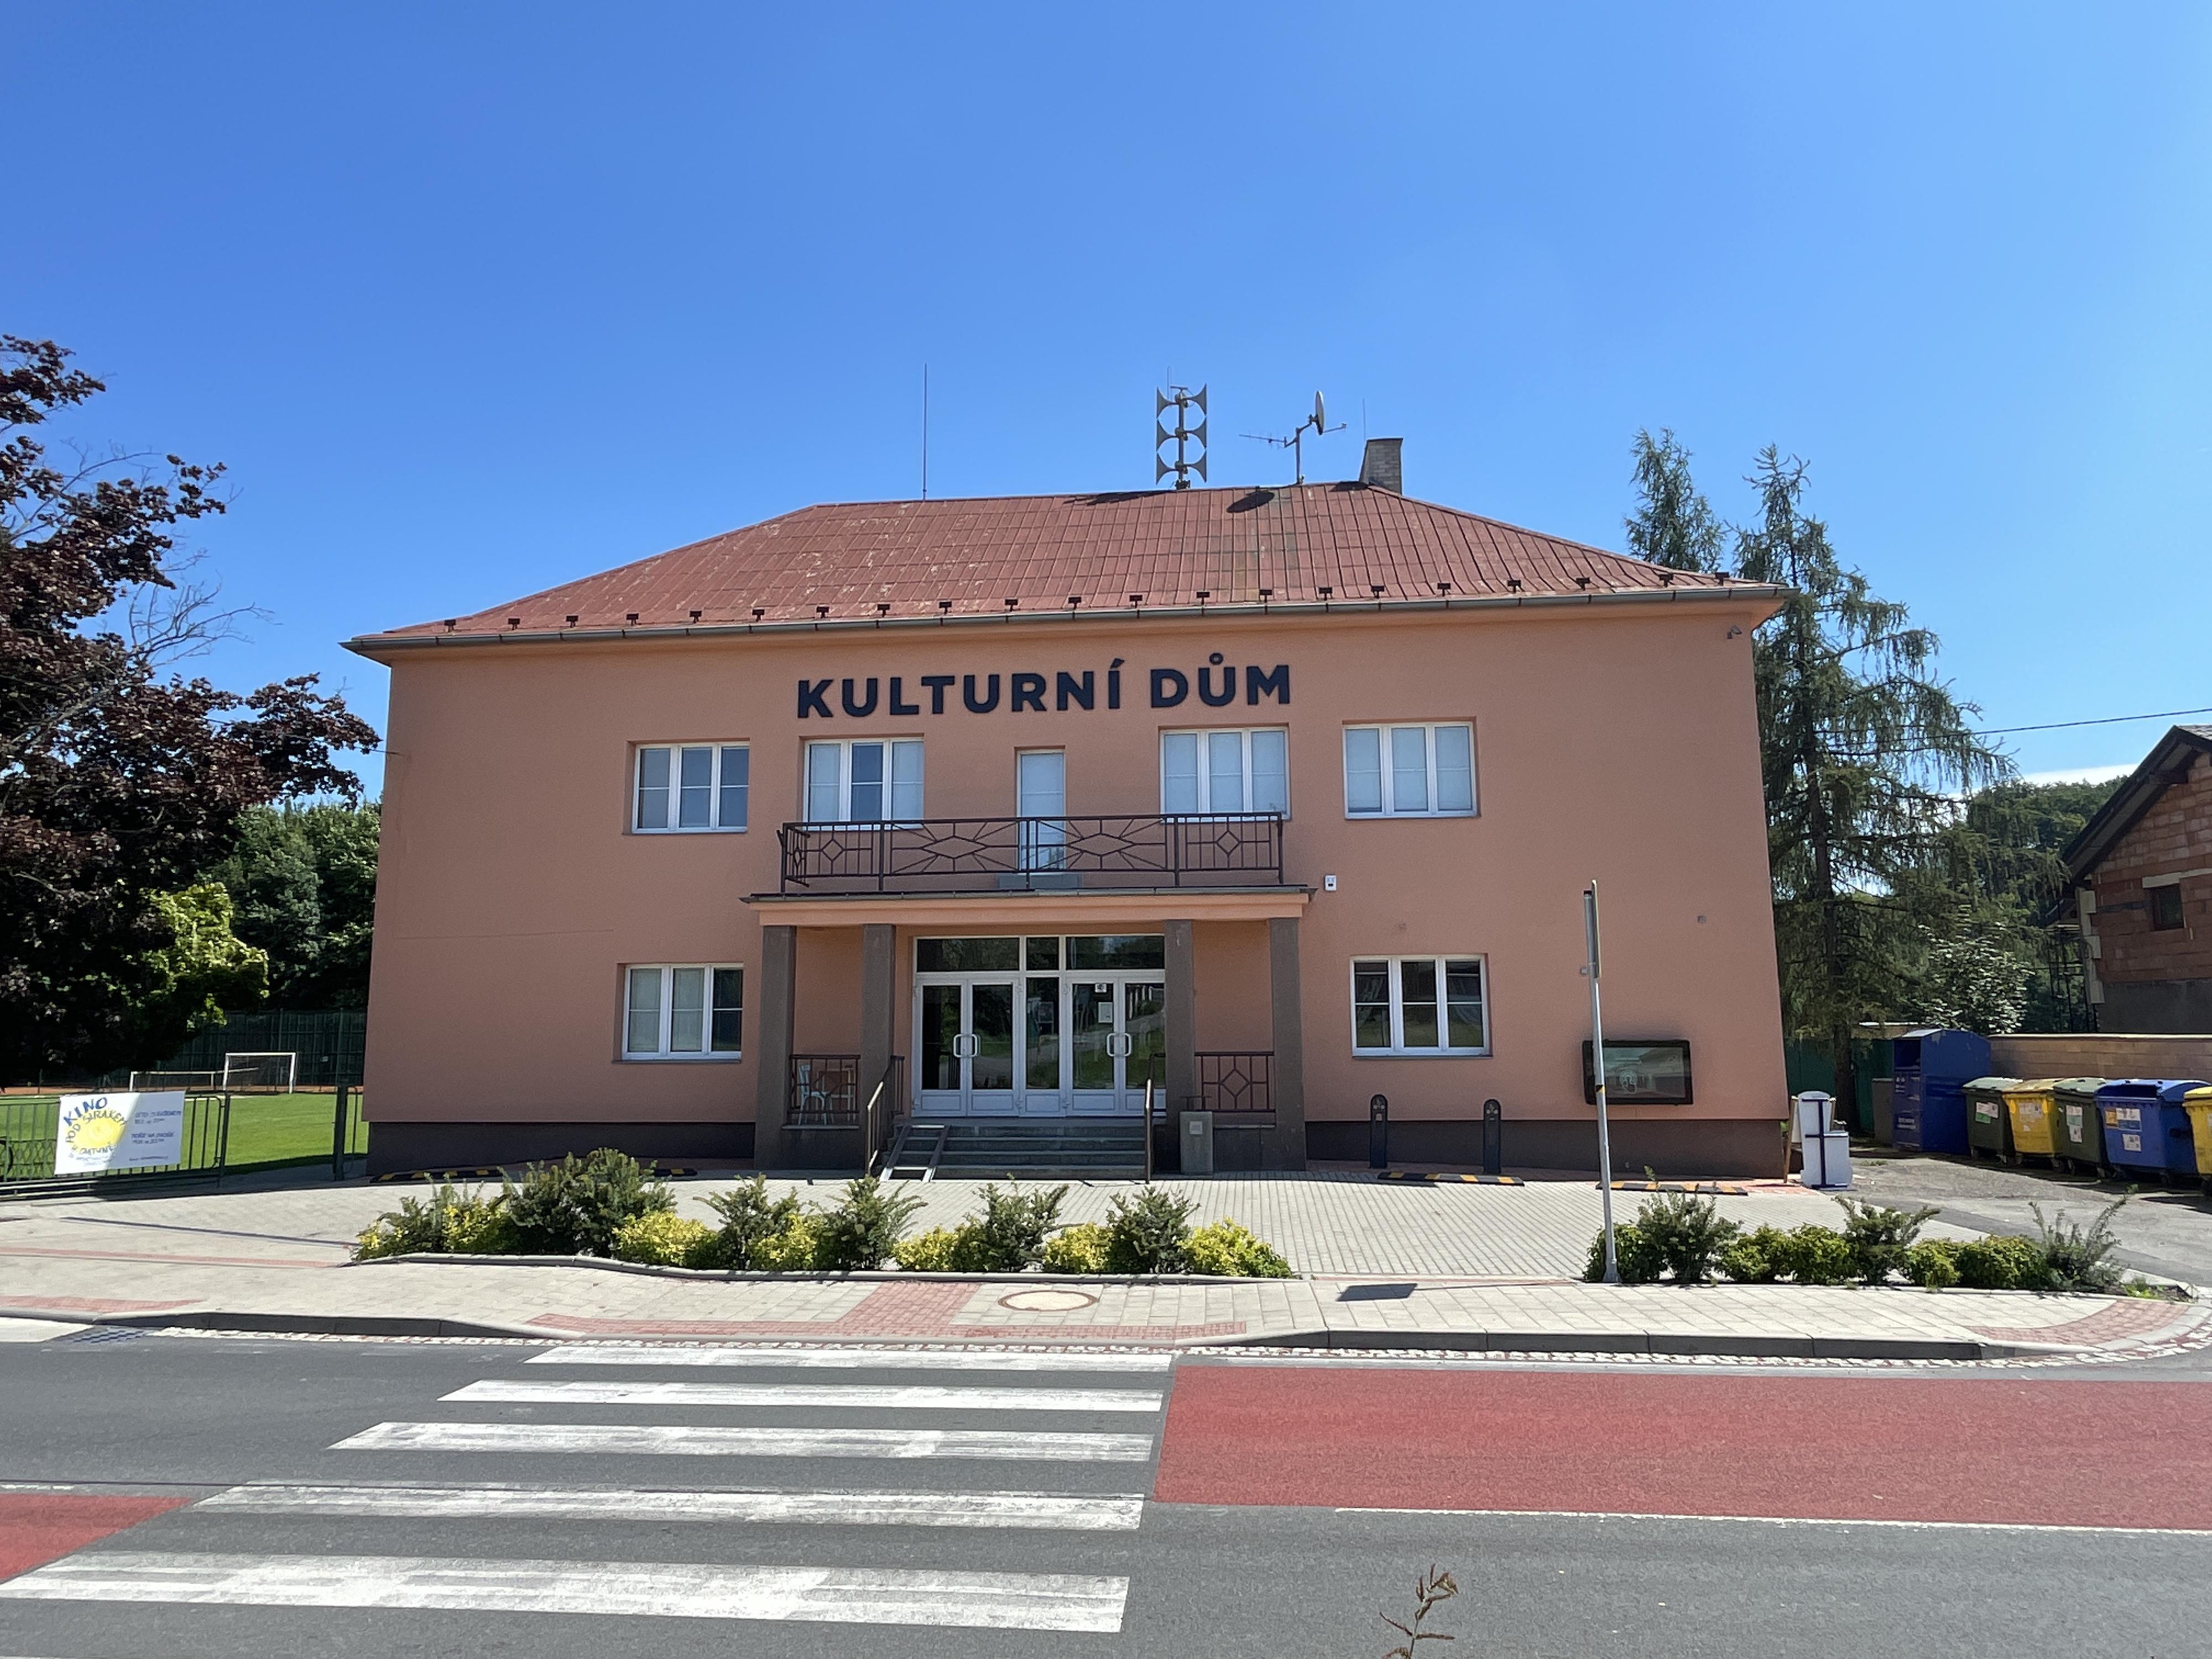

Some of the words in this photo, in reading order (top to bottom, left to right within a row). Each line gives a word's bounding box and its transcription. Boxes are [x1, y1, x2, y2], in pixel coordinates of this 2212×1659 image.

[796, 658, 1125, 718] KULTURNÍ
[1149, 653, 1291, 708] DŮM
[63, 1097, 107, 1126] KINO
[65, 1124, 81, 1143] POD
